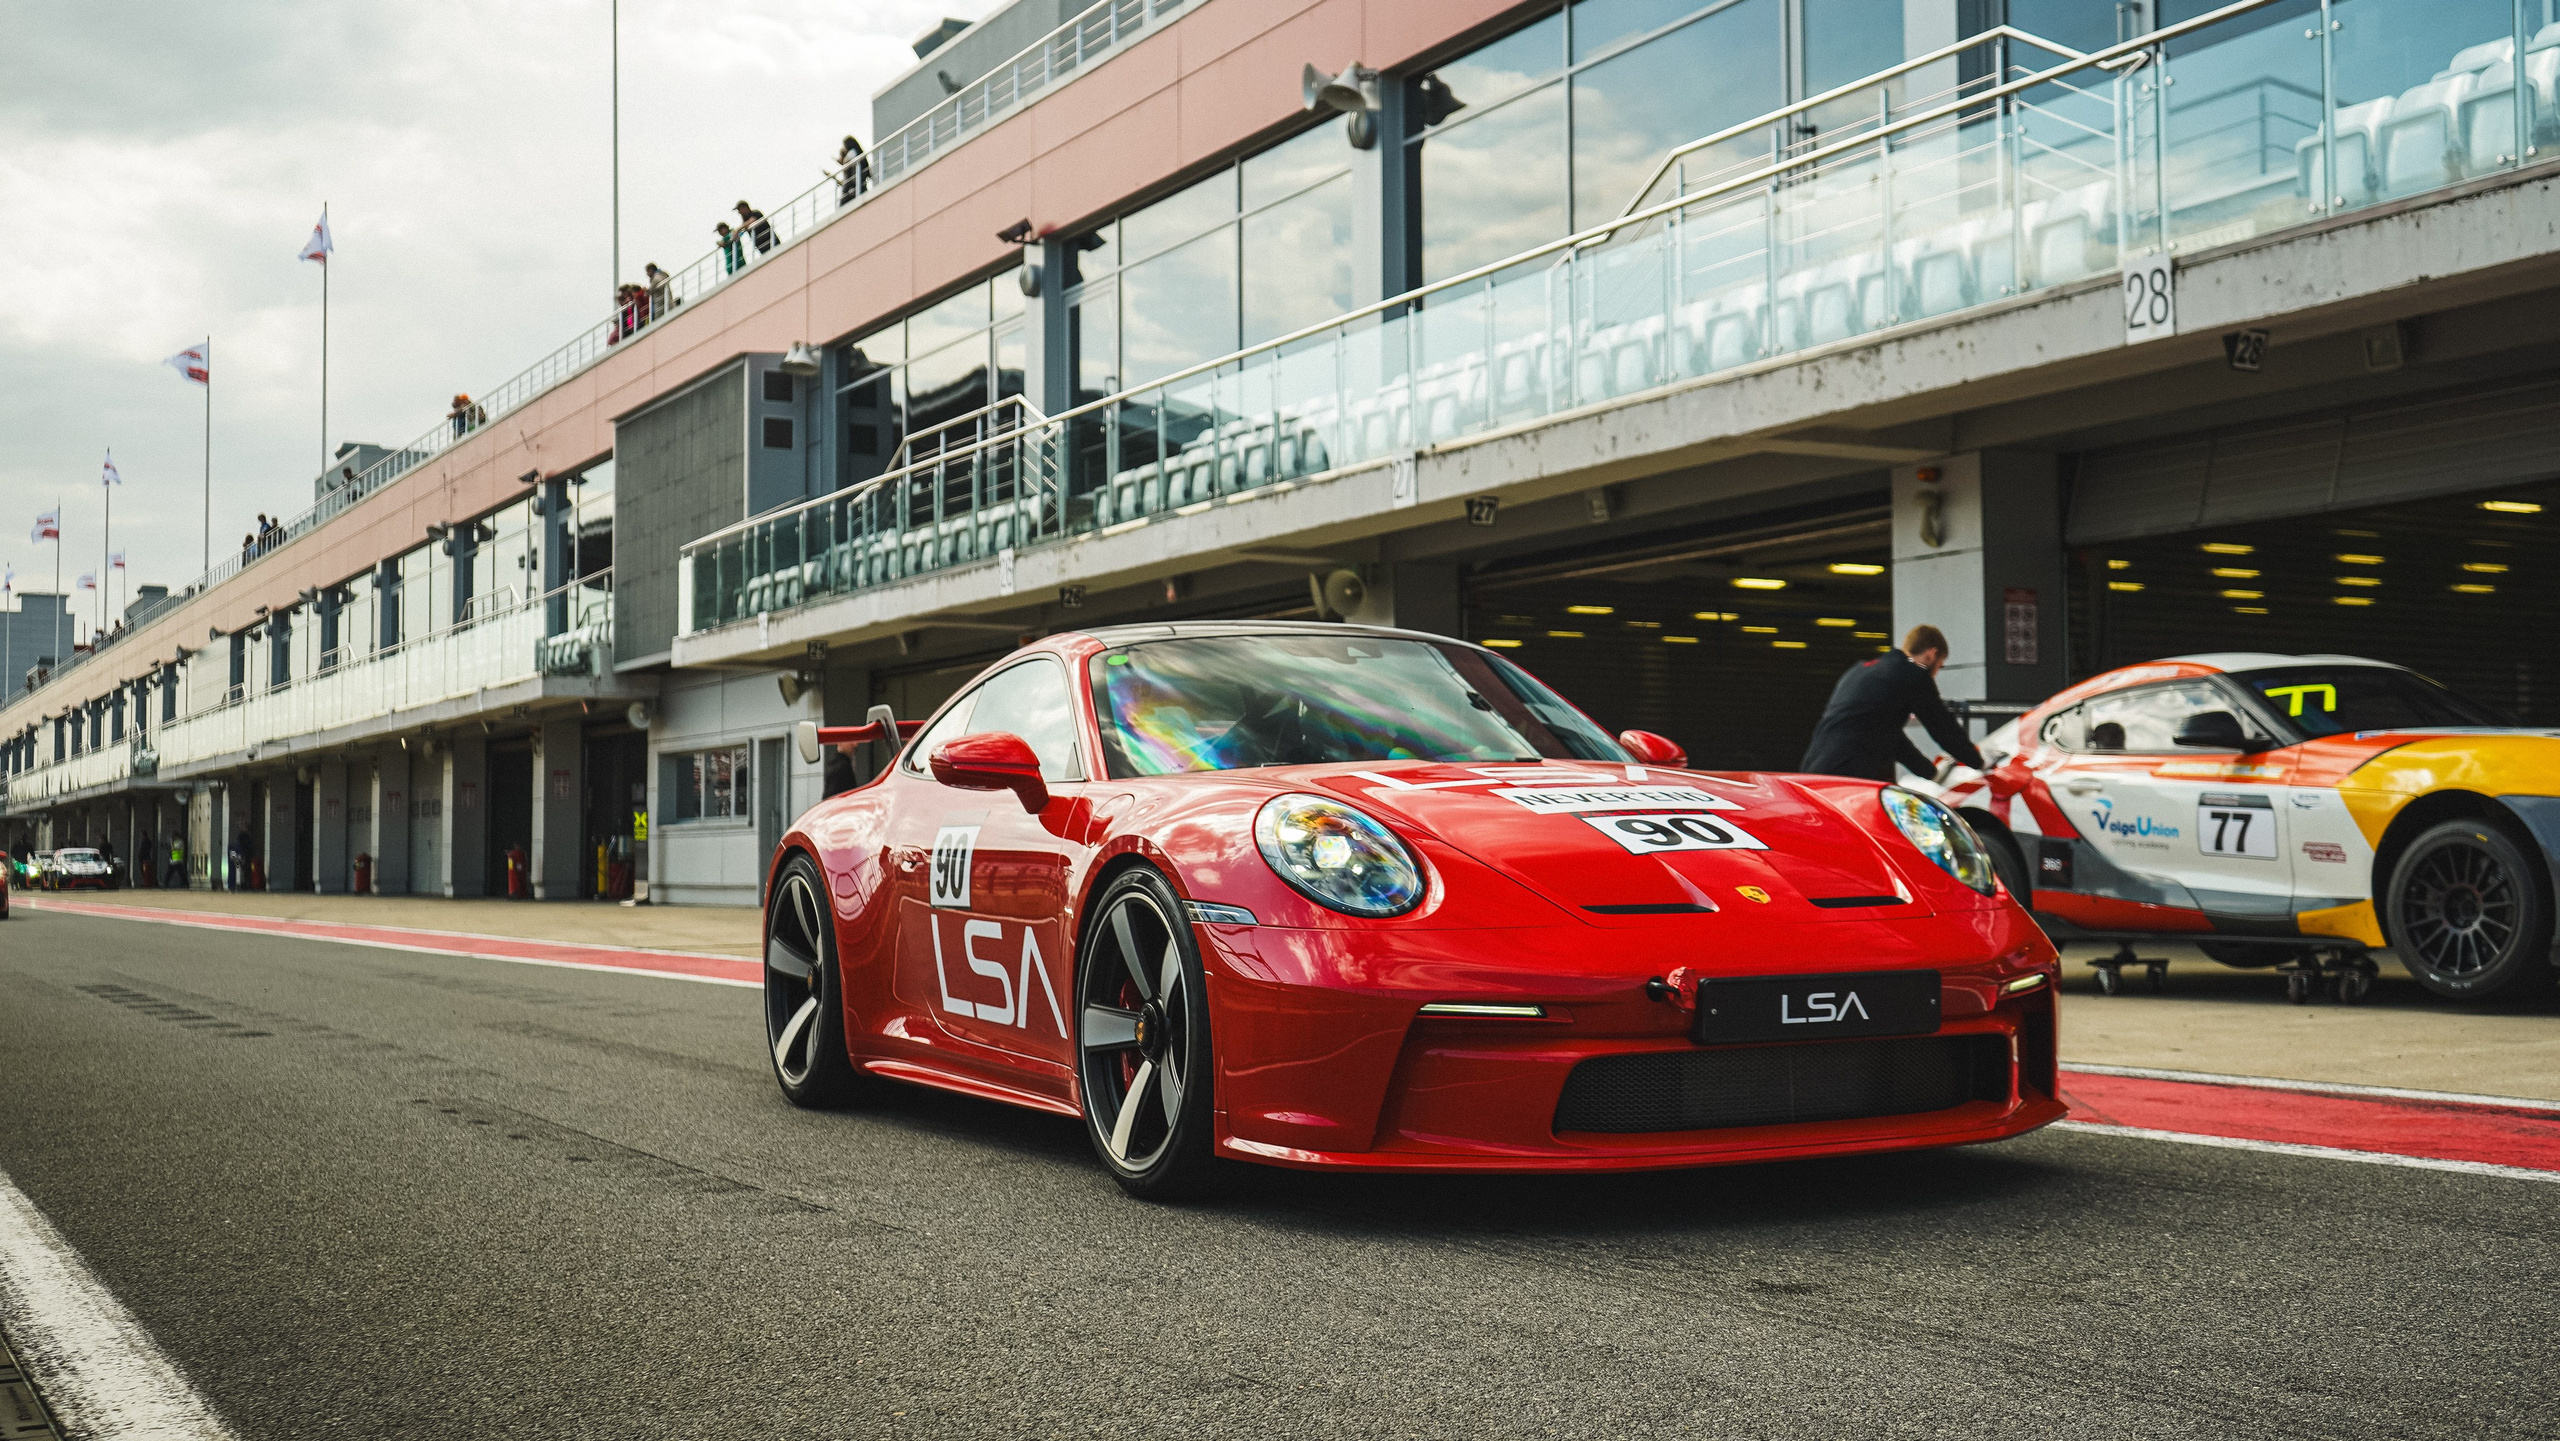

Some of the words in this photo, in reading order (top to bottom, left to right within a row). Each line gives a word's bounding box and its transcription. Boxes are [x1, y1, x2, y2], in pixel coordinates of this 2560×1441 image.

[2127, 268, 2169, 329] 28
[1473, 501, 1495, 522] 27
[2264, 684, 2337, 717] 77
[1615, 817, 1734, 846] 90
[2210, 811, 2252, 852] 77
[936, 832, 969, 899] 90
[1781, 991, 1870, 1024] LSA
